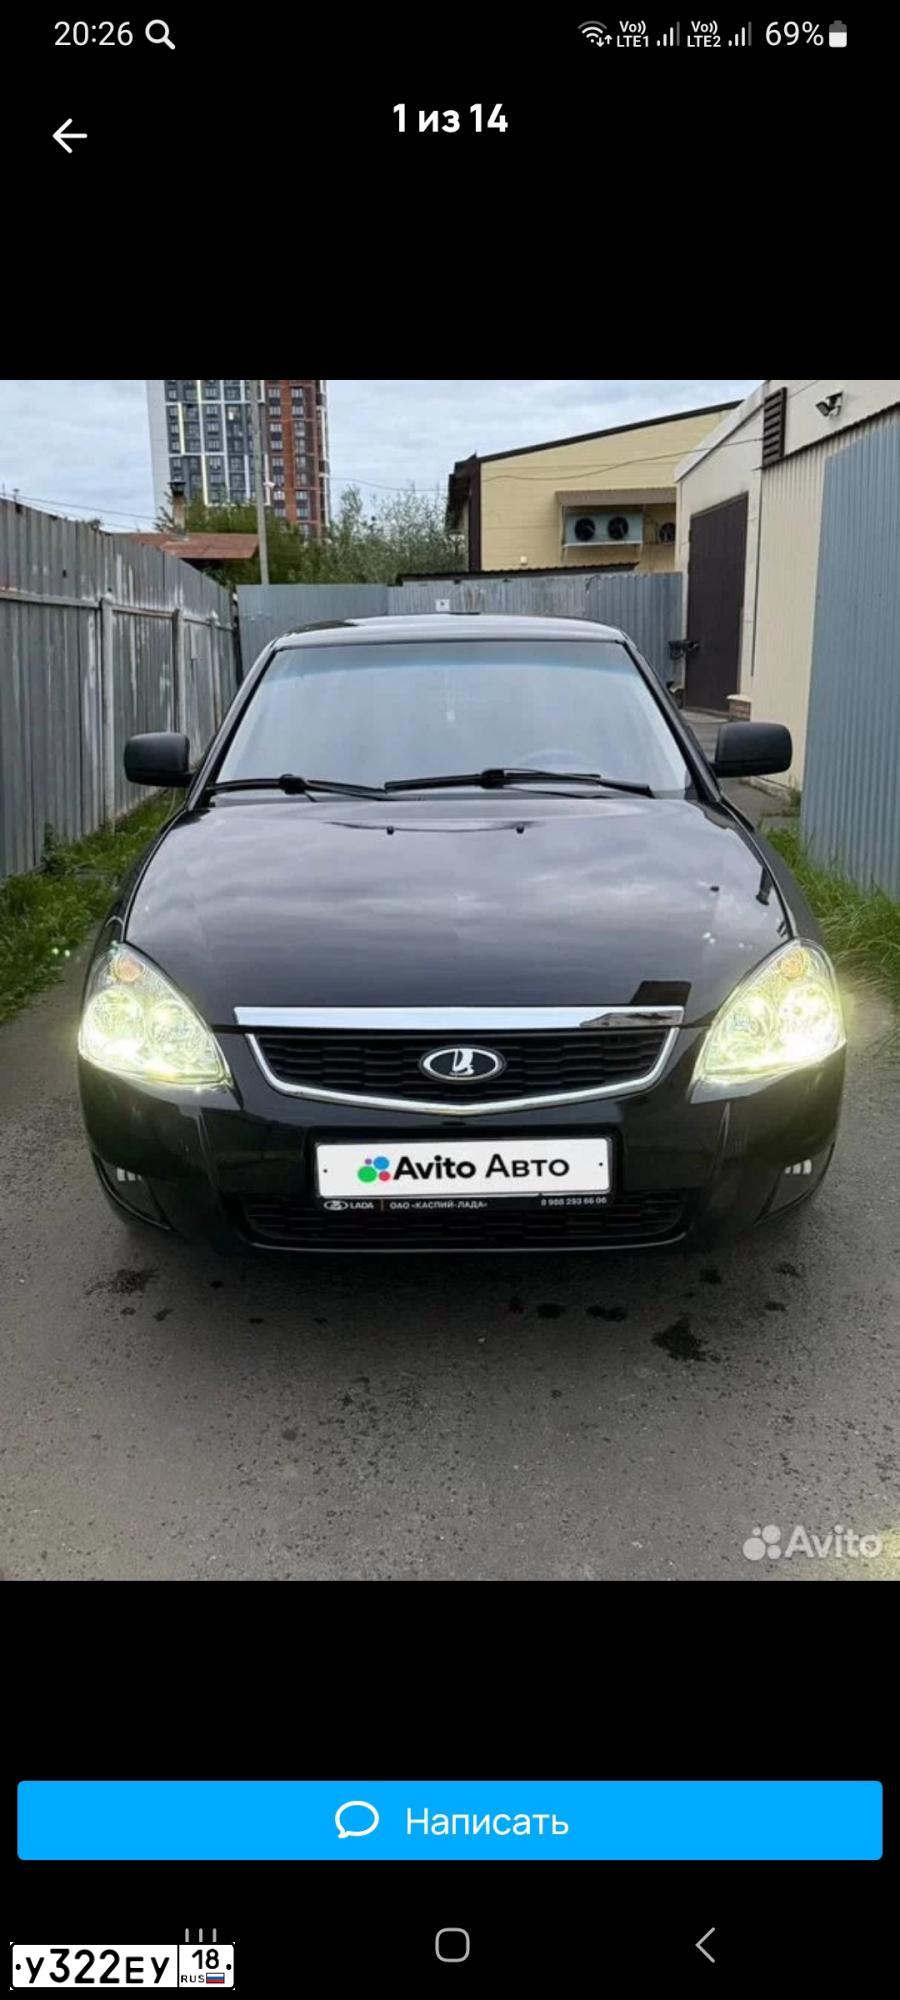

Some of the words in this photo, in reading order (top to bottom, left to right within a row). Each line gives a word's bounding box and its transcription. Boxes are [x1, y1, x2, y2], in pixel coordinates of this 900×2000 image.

[54, 21, 134, 46] 20:26
[616, 35, 649, 48] LTE1
[687, 35, 721, 48] LTE2
[765, 21, 824, 46] 69%
[393, 103, 407, 133] 1
[418, 110, 460, 133] из
[469, 103, 508, 133] 14
[350, 1202, 375, 1210] LADA
[389, 1202, 410, 1210] ОАО
[406, 1807, 569, 1836] Написать
